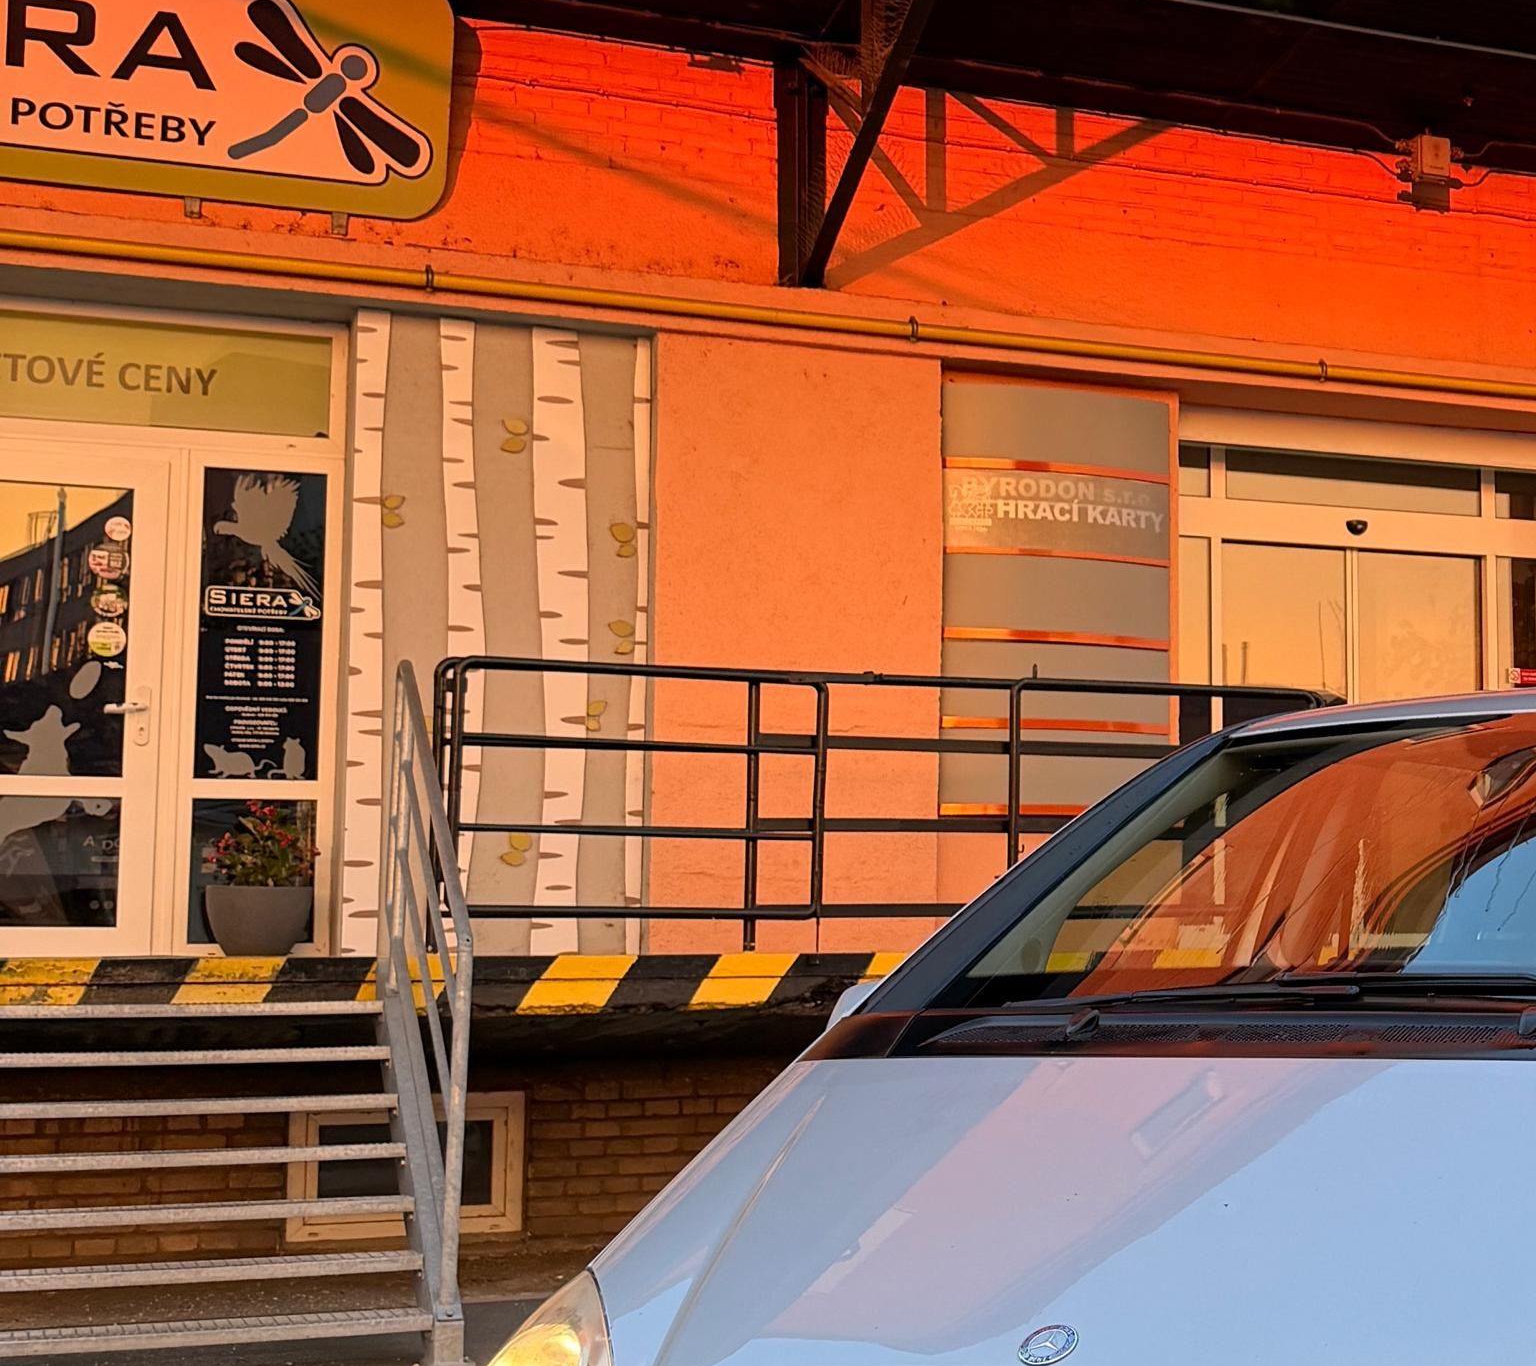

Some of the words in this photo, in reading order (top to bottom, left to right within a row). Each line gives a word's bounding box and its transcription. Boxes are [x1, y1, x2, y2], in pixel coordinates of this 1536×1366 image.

[11, 97, 217, 147] POTŘEBY
[0, 351, 105, 389] TOVÉ
[118, 362, 218, 397] CENY
[997, 499, 1079, 523] HRACÍ
[1087, 505, 1165, 533] KARTY
[209, 589, 288, 608] SIERA
